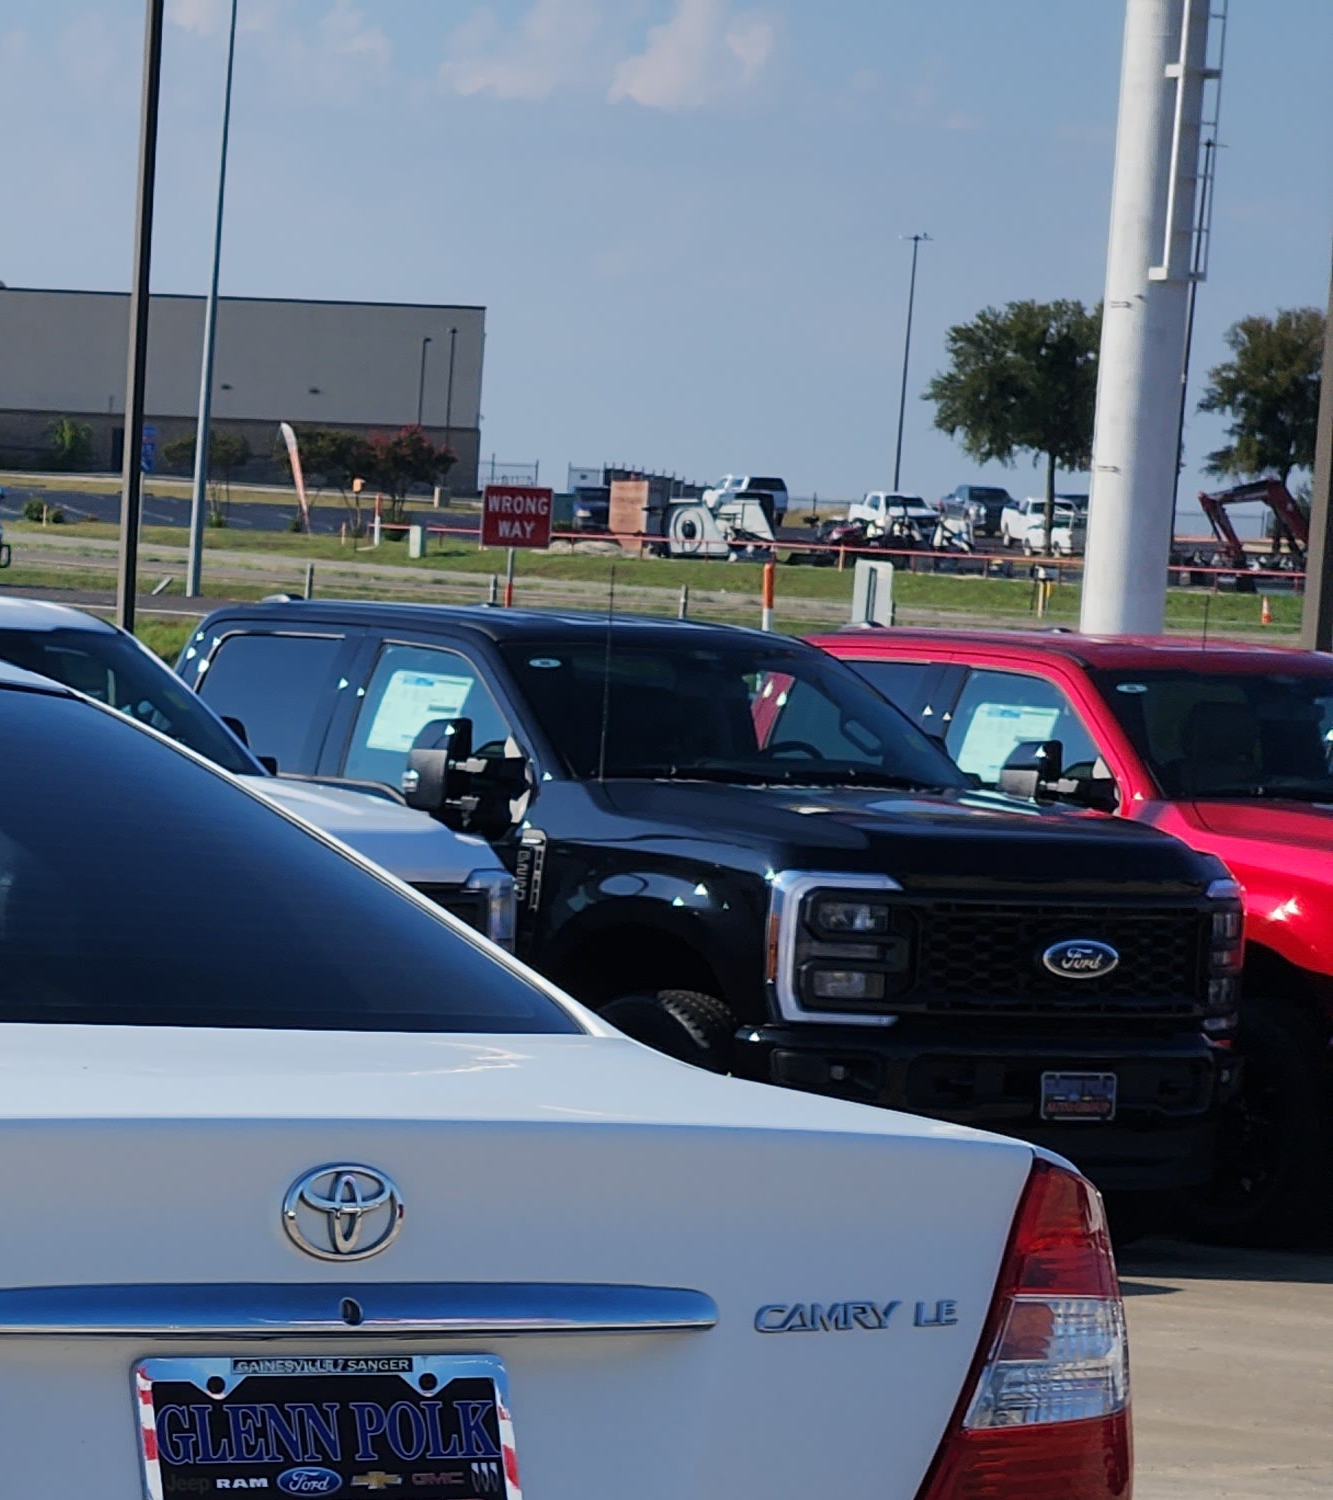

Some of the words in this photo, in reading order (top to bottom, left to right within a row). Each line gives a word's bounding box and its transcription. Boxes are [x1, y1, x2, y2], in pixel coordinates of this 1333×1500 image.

[487, 495, 549, 516] WRONG
[497, 520, 536, 539] WAY
[1060, 947, 1104, 970] Ford
[753, 1299, 902, 1334] CAMRY
[913, 1299, 959, 1328] LE
[236, 1360, 333, 1374] GAINESVILLE
[347, 1359, 410, 1372] SANGER
[155, 1404, 343, 1466] GLENN
[351, 1400, 503, 1462] POLK
[215, 1477, 269, 1490] RAM
[287, 1469, 334, 1493] Ford
[411, 1472, 466, 1486] GMC
